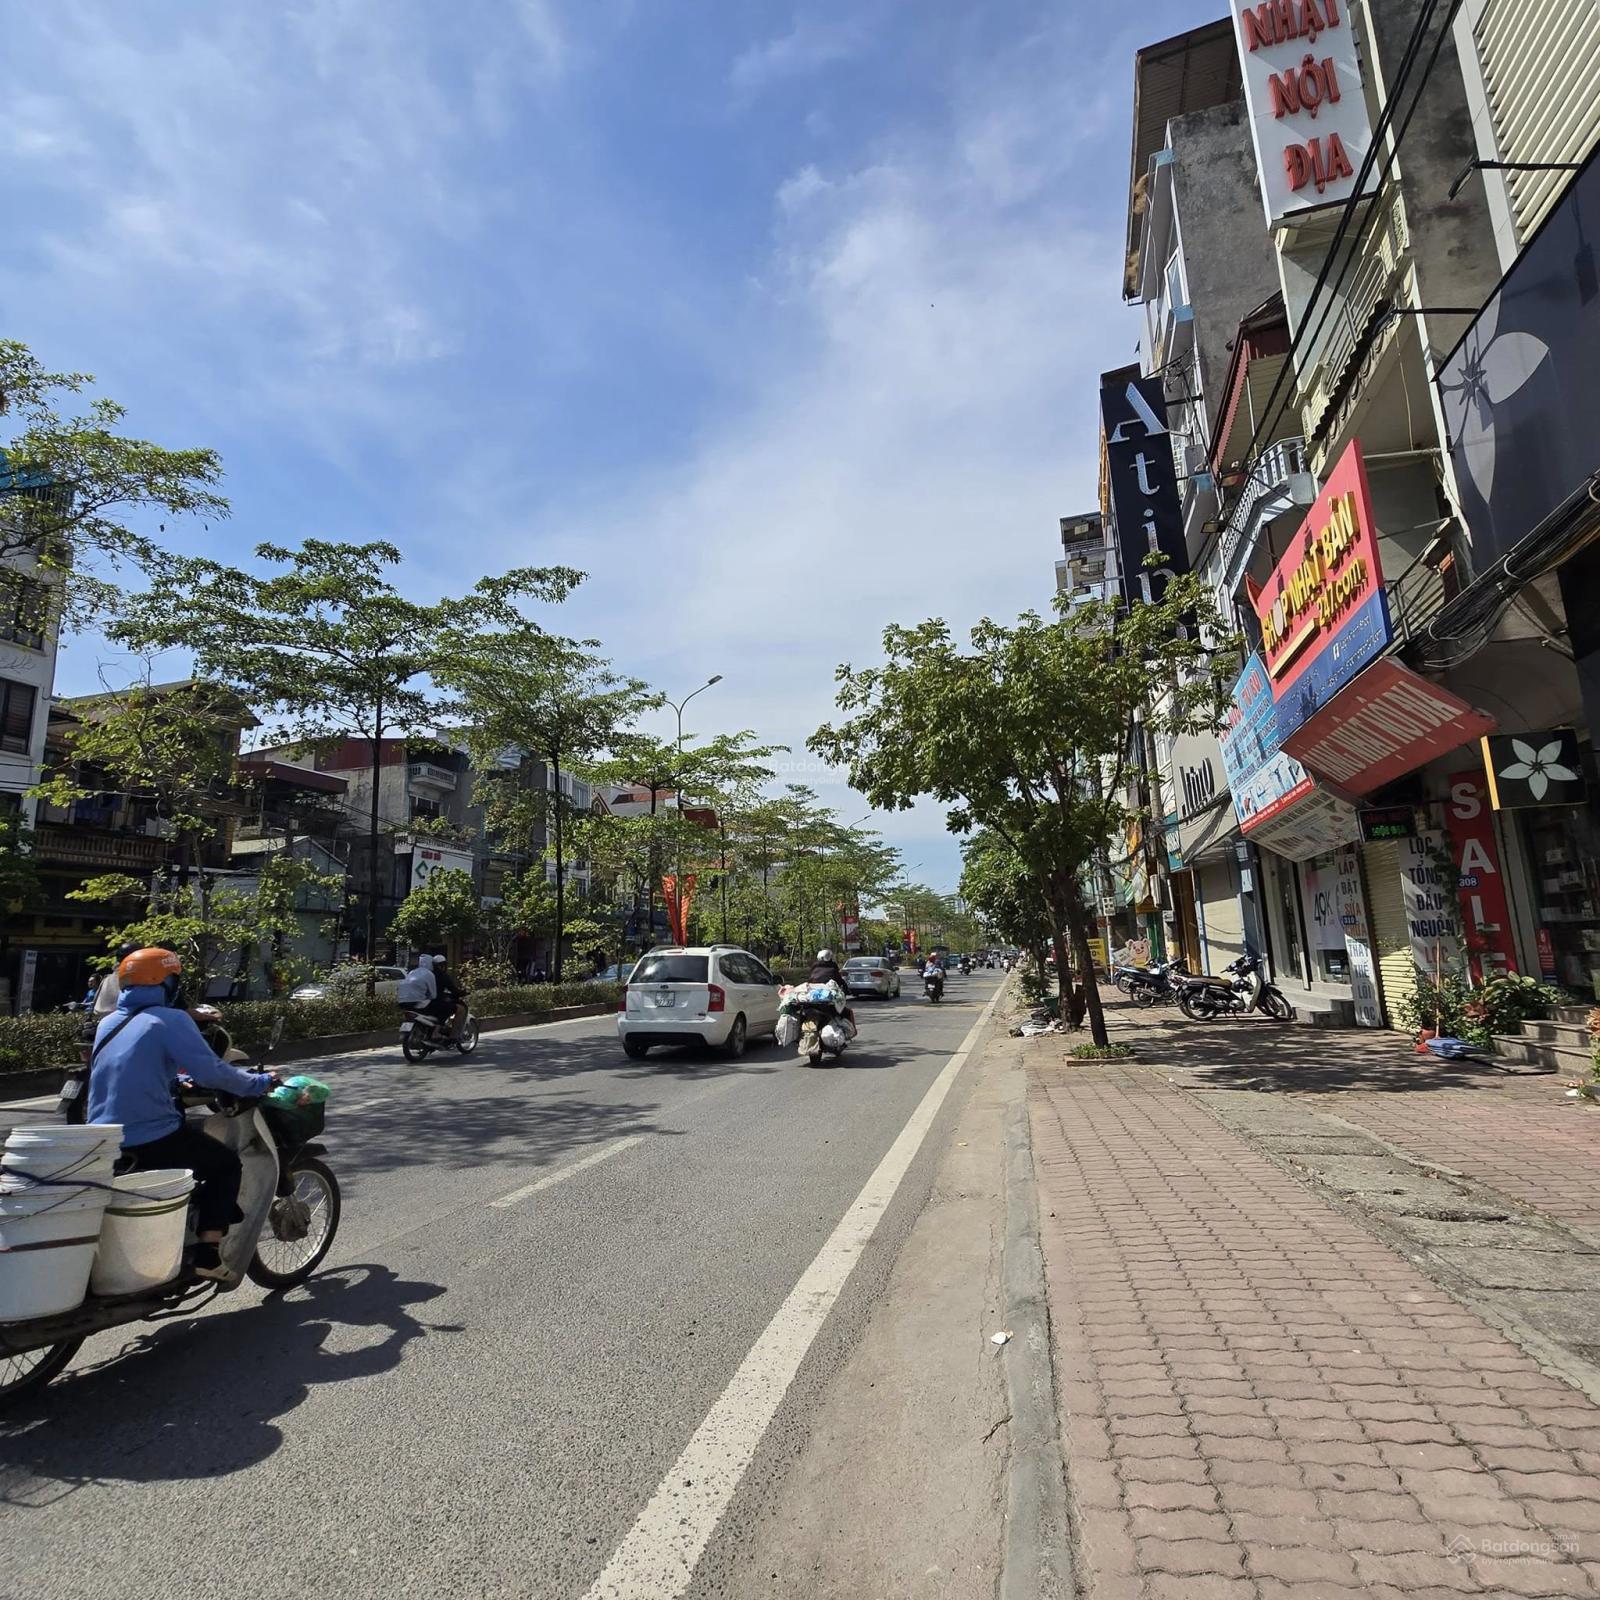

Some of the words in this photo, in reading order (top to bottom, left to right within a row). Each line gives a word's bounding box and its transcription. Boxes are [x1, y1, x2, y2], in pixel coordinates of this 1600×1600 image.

[1268, 53, 1341, 119] NỘI
[1284, 132, 1354, 194] ĐỊA
[1356, 696, 1436, 744] NỘI
[1382, 680, 1465, 729] ĐỊA
[1327, 716, 1404, 765] NHẬT
[1451, 782, 1507, 976] SALE
[1458, 877, 1478, 887] 308
[1313, 890, 1334, 927] 49K
